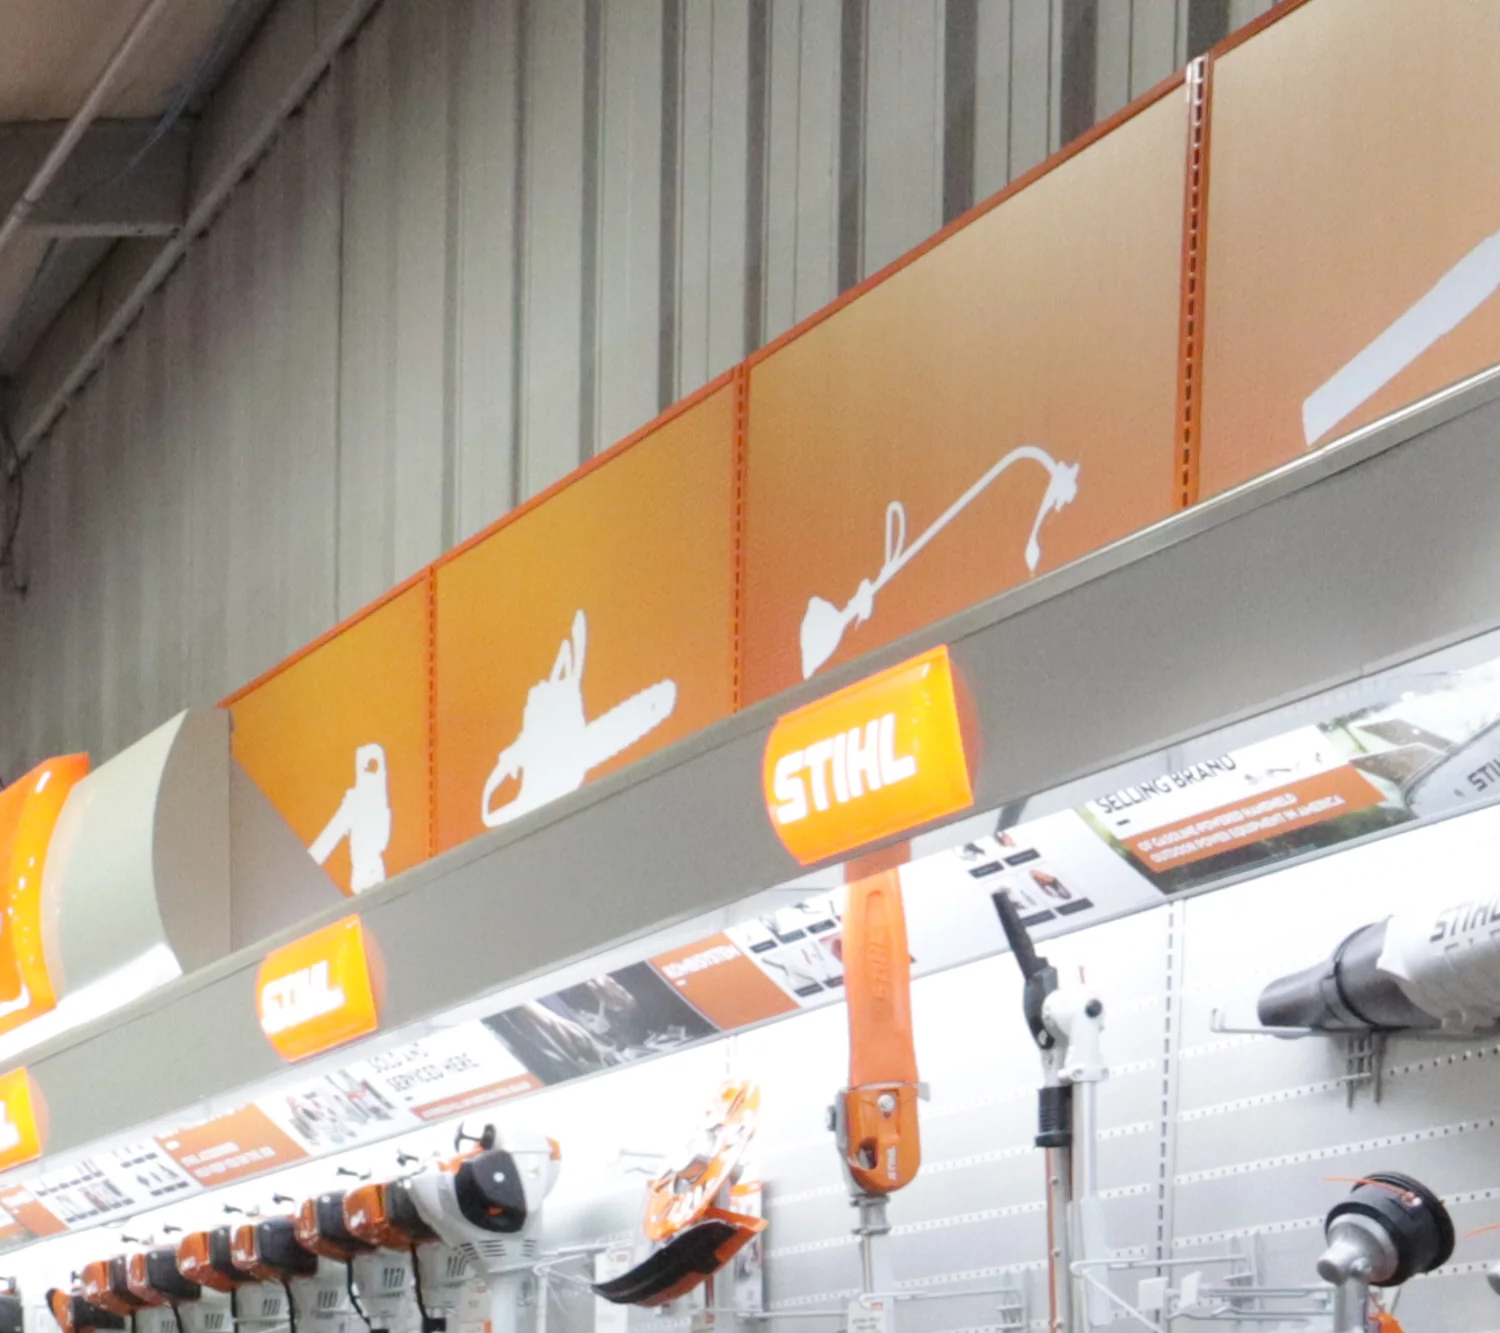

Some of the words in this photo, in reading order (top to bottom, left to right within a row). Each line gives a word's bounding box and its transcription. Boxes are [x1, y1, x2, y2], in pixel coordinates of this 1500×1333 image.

[773, 711, 918, 825] STIHL
[1096, 779, 1170, 814] SELLING
[1170, 754, 1237, 789] BRAND
[1467, 757, 1500, 792] STI
